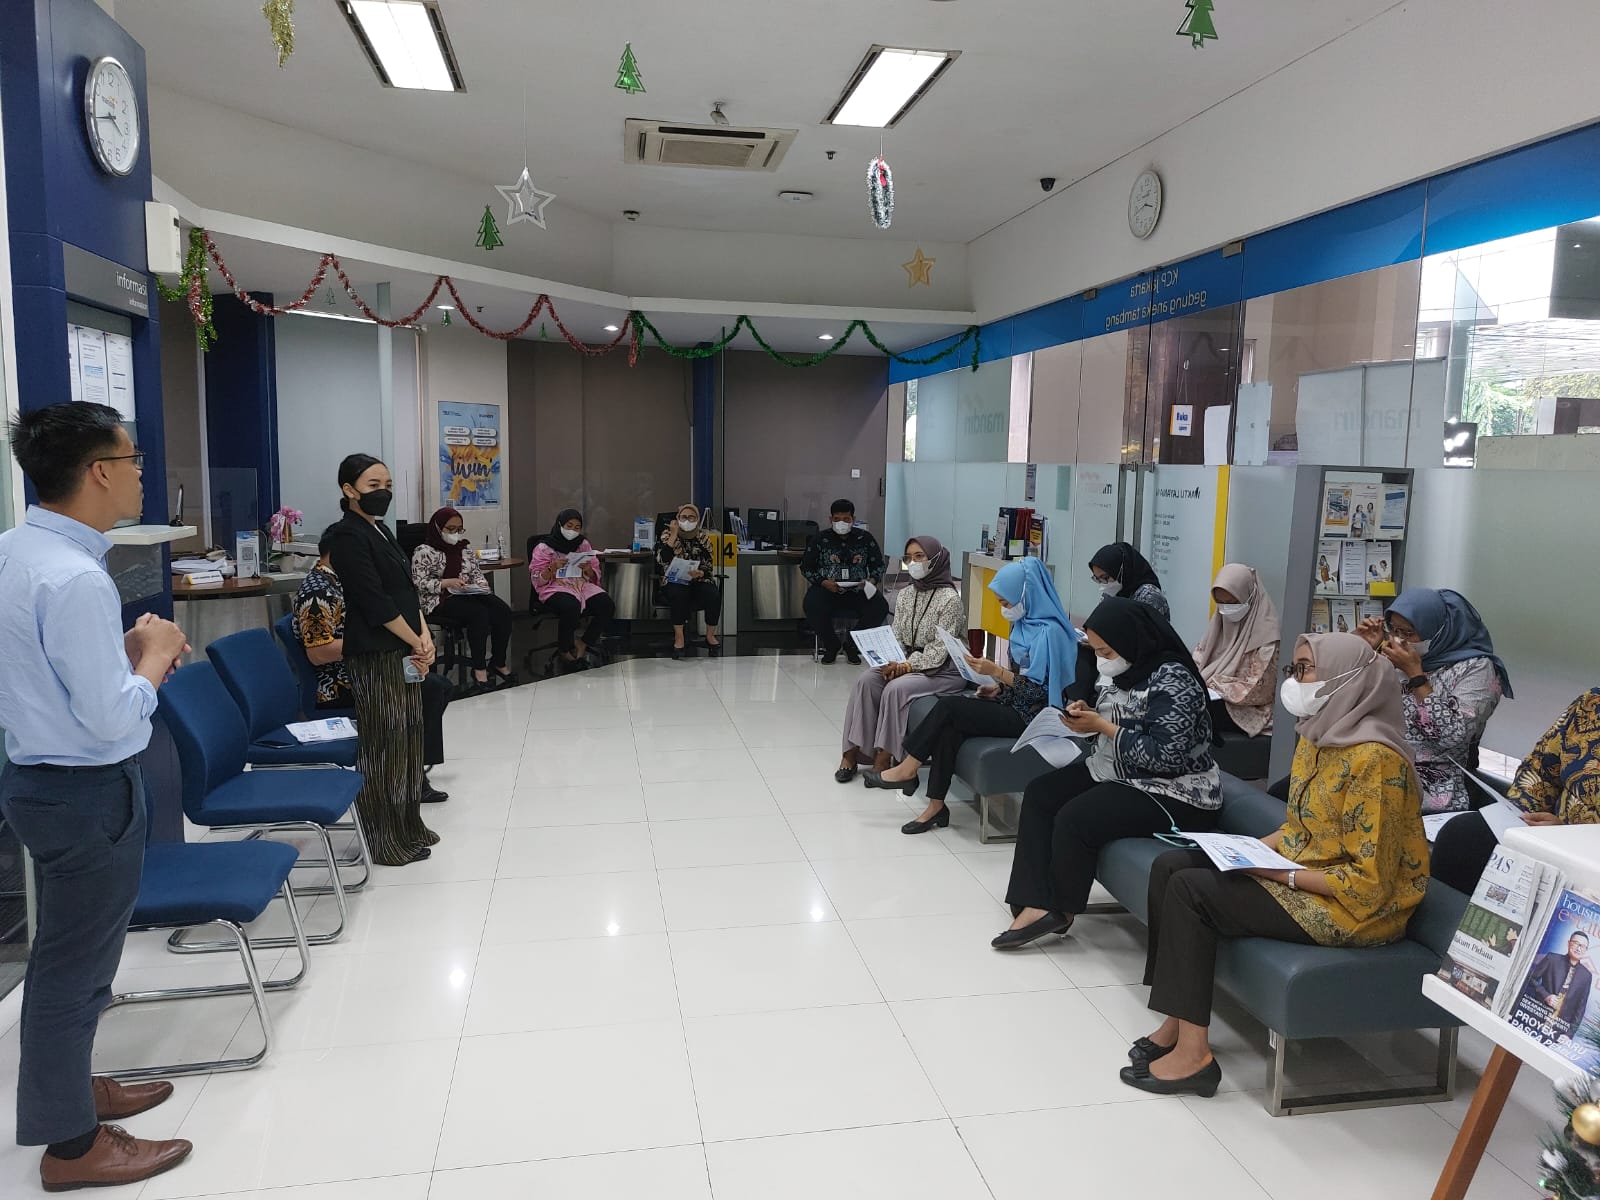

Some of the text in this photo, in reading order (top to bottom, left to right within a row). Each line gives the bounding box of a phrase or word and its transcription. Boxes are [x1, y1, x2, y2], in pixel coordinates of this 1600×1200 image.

[116, 271, 148, 296] informasi
[724, 542, 735, 560] 4
[1562, 893, 1600, 921] housin
[1511, 1019, 1543, 1044] PASCA
[1515, 1009, 1558, 1039] PROYEK
